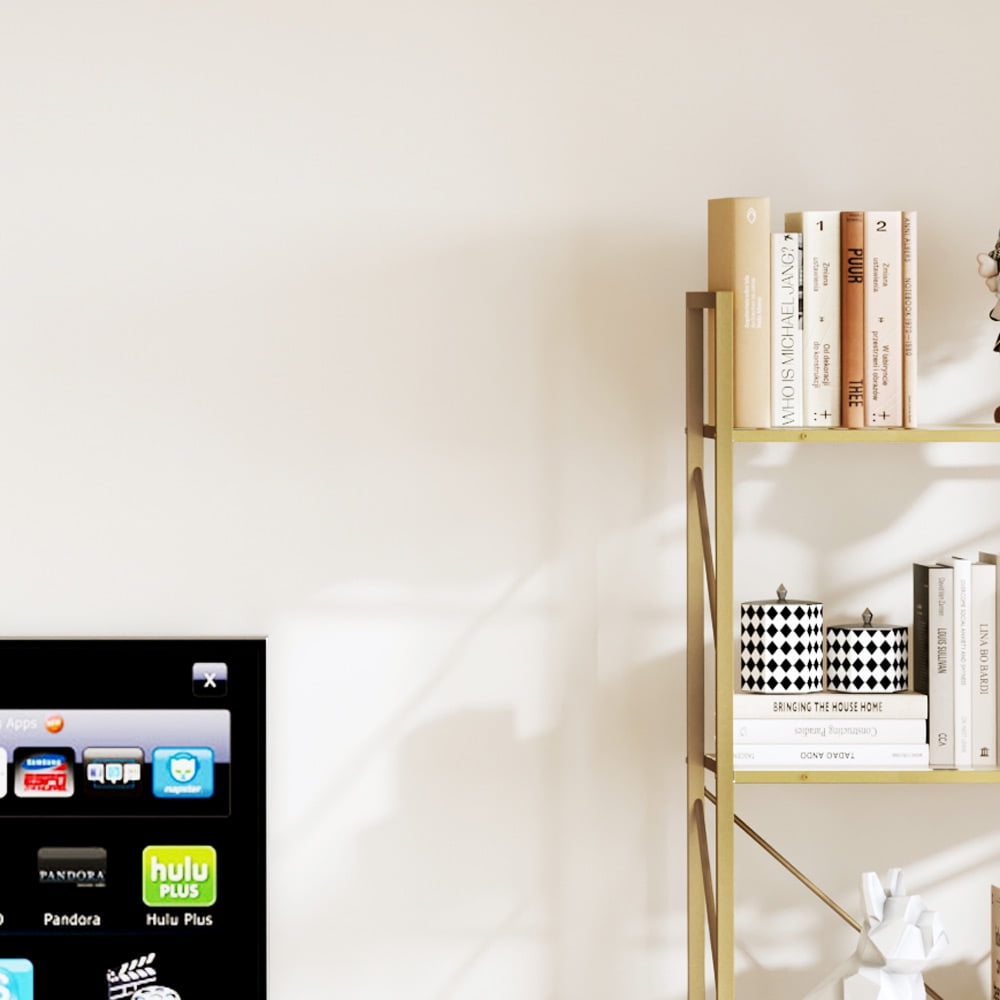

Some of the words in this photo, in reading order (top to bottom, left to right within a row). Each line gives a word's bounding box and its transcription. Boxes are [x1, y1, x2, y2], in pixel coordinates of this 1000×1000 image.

[816, 220, 824, 232] 1
[876, 220, 887, 232] 2
[781, 246, 795, 298] JANG?
[812, 257, 820, 292] ustawienia
[822, 262, 830, 287] Zmiana
[848, 247, 864, 284] PUUR
[872, 257, 880, 292] ustawienia
[904, 278, 912, 316] NOTEBOOK
[781, 299, 795, 364] MICHAEL
[812, 341, 820, 350] do
[823, 343, 831, 354] Od
[871, 331, 880, 368] przestrzeni
[781, 366, 795, 382] IS
[811, 351, 820, 389] konstrukcji
[821, 355, 831, 387] dekoracji
[881, 354, 890, 386] labiryncie
[848, 379, 864, 408] THEE
[781, 383, 795, 427] WHO
[960, 609, 968, 627] SOCIAL
[937, 627, 948, 645] LOUIS
[960, 628, 968, 650] ANXIETY
[979, 623, 990, 647] LINA
[937, 646, 948, 674] SULLIVAN
[960, 651, 968, 663] AND
[979, 648, 990, 663] BO
[979, 665, 990, 695] BARDI
[774, 702, 812, 712] BRINGING
[814, 702, 830, 712] THE
[832, 702, 858, 712] HOUSE
[860, 702, 882, 712] HOME
[6, 718, 38, 731] Apps
[828, 726, 878, 737] Constructing
[937, 732, 948, 747] CCA
[800, 752, 824, 760] ANDO
[826, 752, 854, 760] TADAO
[39, 870, 106, 882] PANDORA
[151, 856, 208, 882] hulu
[160, 884, 199, 898] PLUS
[44, 913, 101, 926] Pandora
[146, 914, 179, 926] Hulu
[184, 913, 213, 926] Plus
